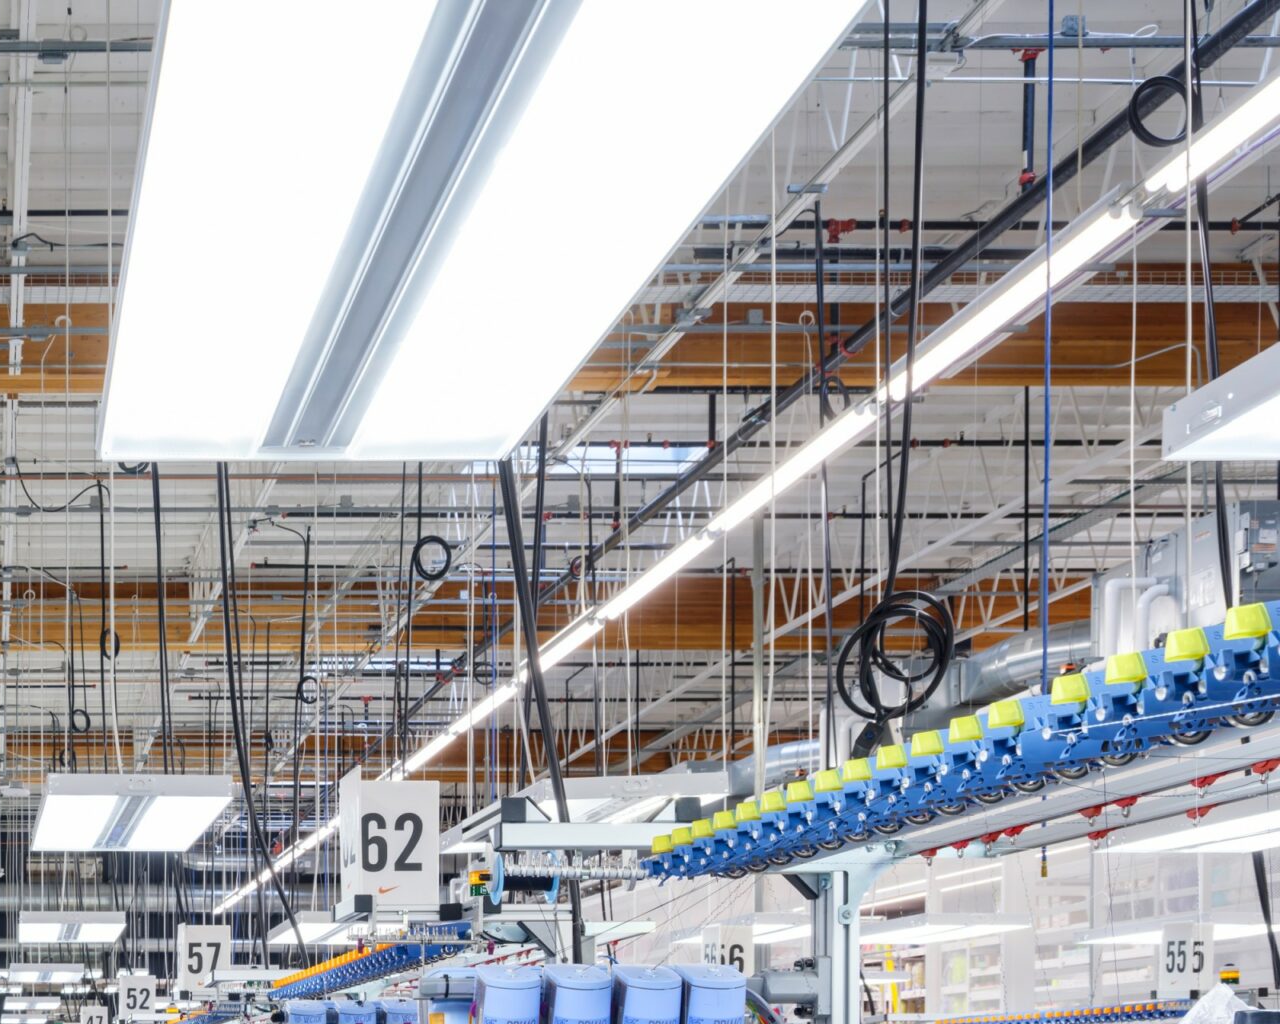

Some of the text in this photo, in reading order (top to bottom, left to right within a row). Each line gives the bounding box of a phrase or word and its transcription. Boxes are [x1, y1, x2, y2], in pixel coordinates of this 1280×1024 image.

[361, 812, 424, 873] 62
[187, 942, 221, 975] 57
[1165, 940, 1187, 973] 55
[1192, 941, 1205, 973] 5
[126, 987, 151, 1010] 52
